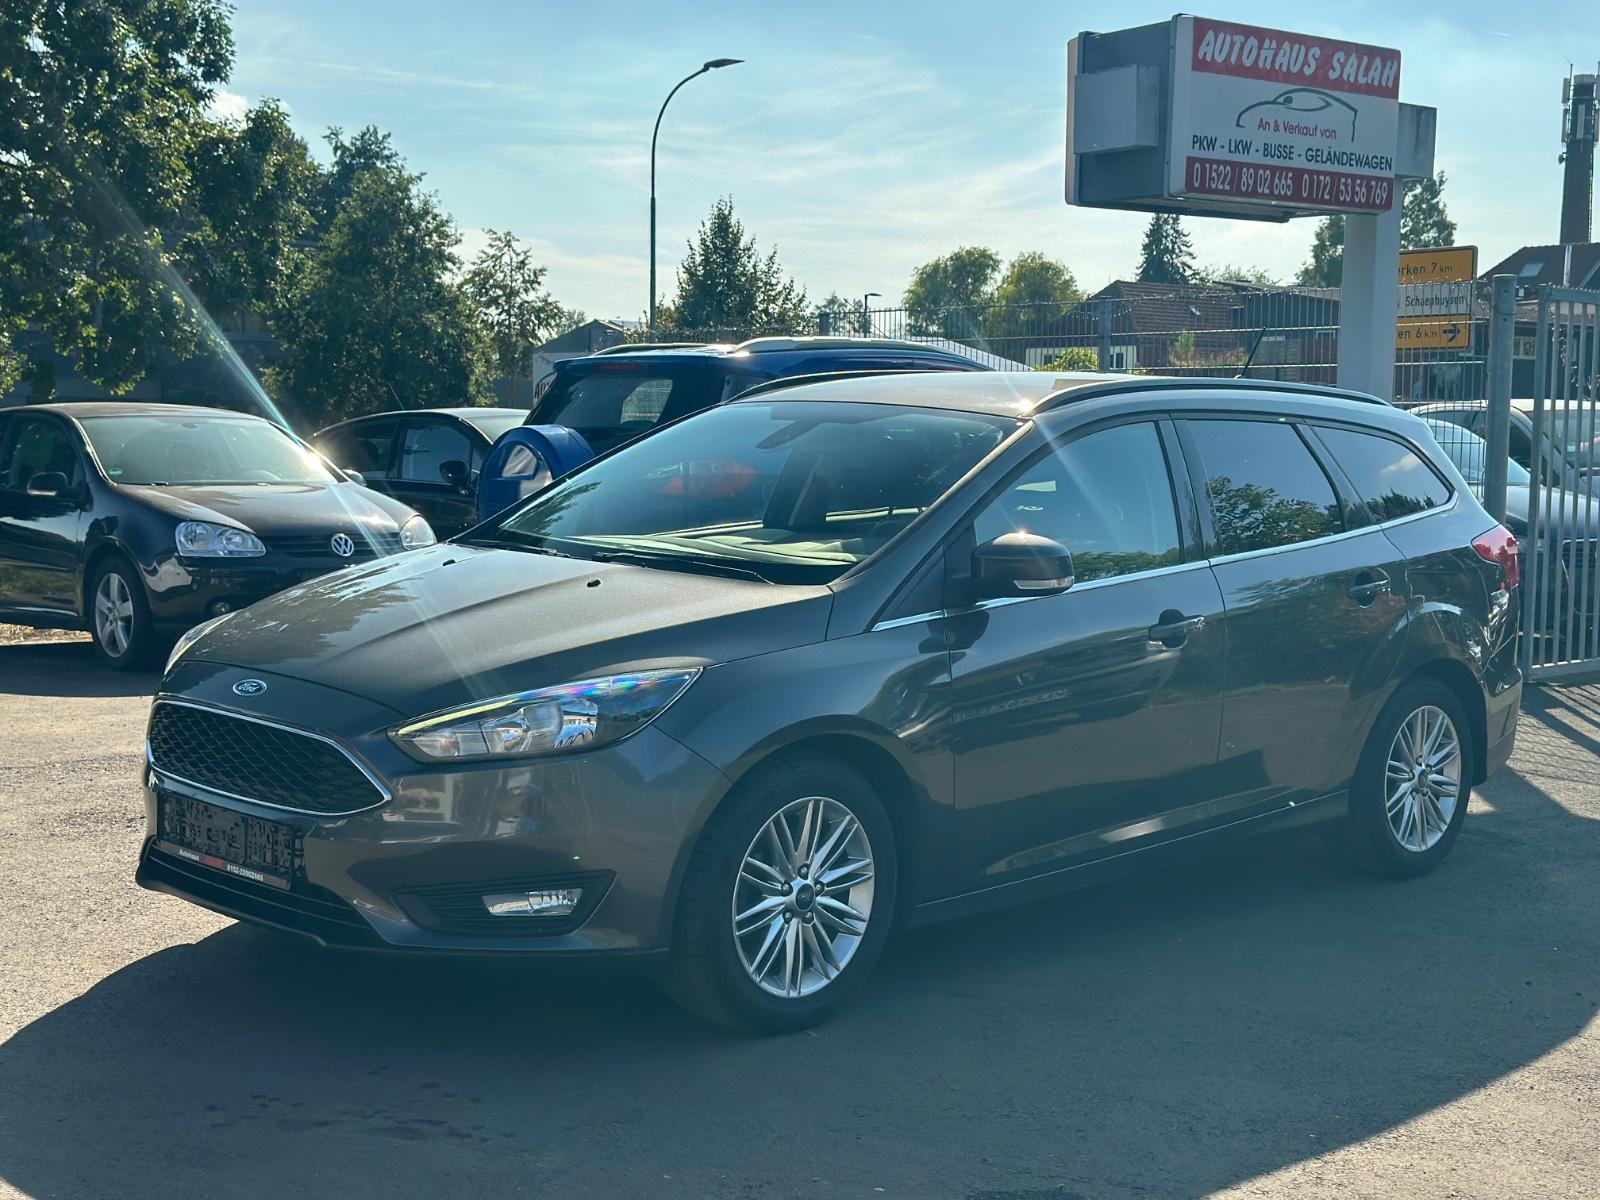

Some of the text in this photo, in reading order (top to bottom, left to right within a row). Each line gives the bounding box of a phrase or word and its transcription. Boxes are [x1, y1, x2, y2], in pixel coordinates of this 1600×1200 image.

[1198, 30, 1398, 88] AUTOHAUS SALAH
[1258, 118, 1337, 139] An & Verkauf von
[1192, 134, 1217, 152] PKW
[1228, 138, 1252, 155] LKW
[1263, 142, 1294, 160] BUSSE
[1305, 146, 1392, 171] GELÄNDEWAGEN
[1193, 162, 1201, 188] 0
[1205, 163, 1232, 190] 1522
[1241, 167, 1255, 193] 89
[1257, 169, 1271, 194] 02
[1273, 171, 1293, 196] 665
[1302, 173, 1310, 198] 0
[1313, 174, 1330, 199] 172
[1339, 177, 1352, 202] 53
[1354, 179, 1367, 203] 56
[1369, 181, 1388, 205] 769
[1431, 262, 1438, 274] 7
[1440, 265, 1453, 273] km
[1405, 294, 1464, 308] Schaephuysen
[1416, 327, 1422, 338] 6
[1424, 330, 1438, 338] km
